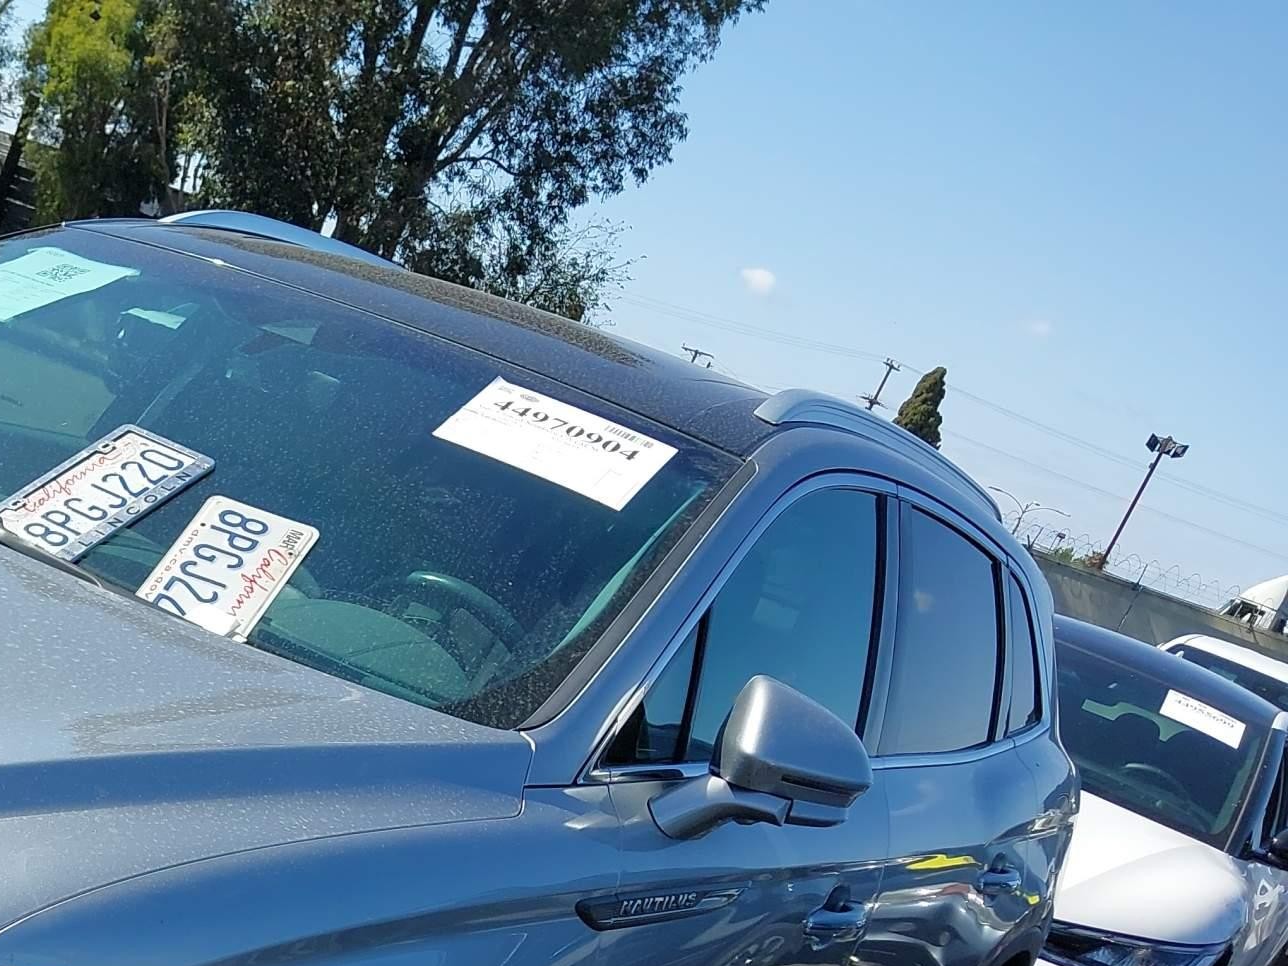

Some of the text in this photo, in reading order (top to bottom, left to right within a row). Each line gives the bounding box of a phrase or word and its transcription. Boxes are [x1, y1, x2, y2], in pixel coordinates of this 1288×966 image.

[493, 400, 641, 461] 44970904
[23, 451, 116, 513] California
[23, 449, 185, 547] 8PGJ220
[78, 472, 193, 547] LINCOLN
[144, 529, 200, 600] dmv.ca.gov
[619, 892, 698, 916] NAUTILUS
